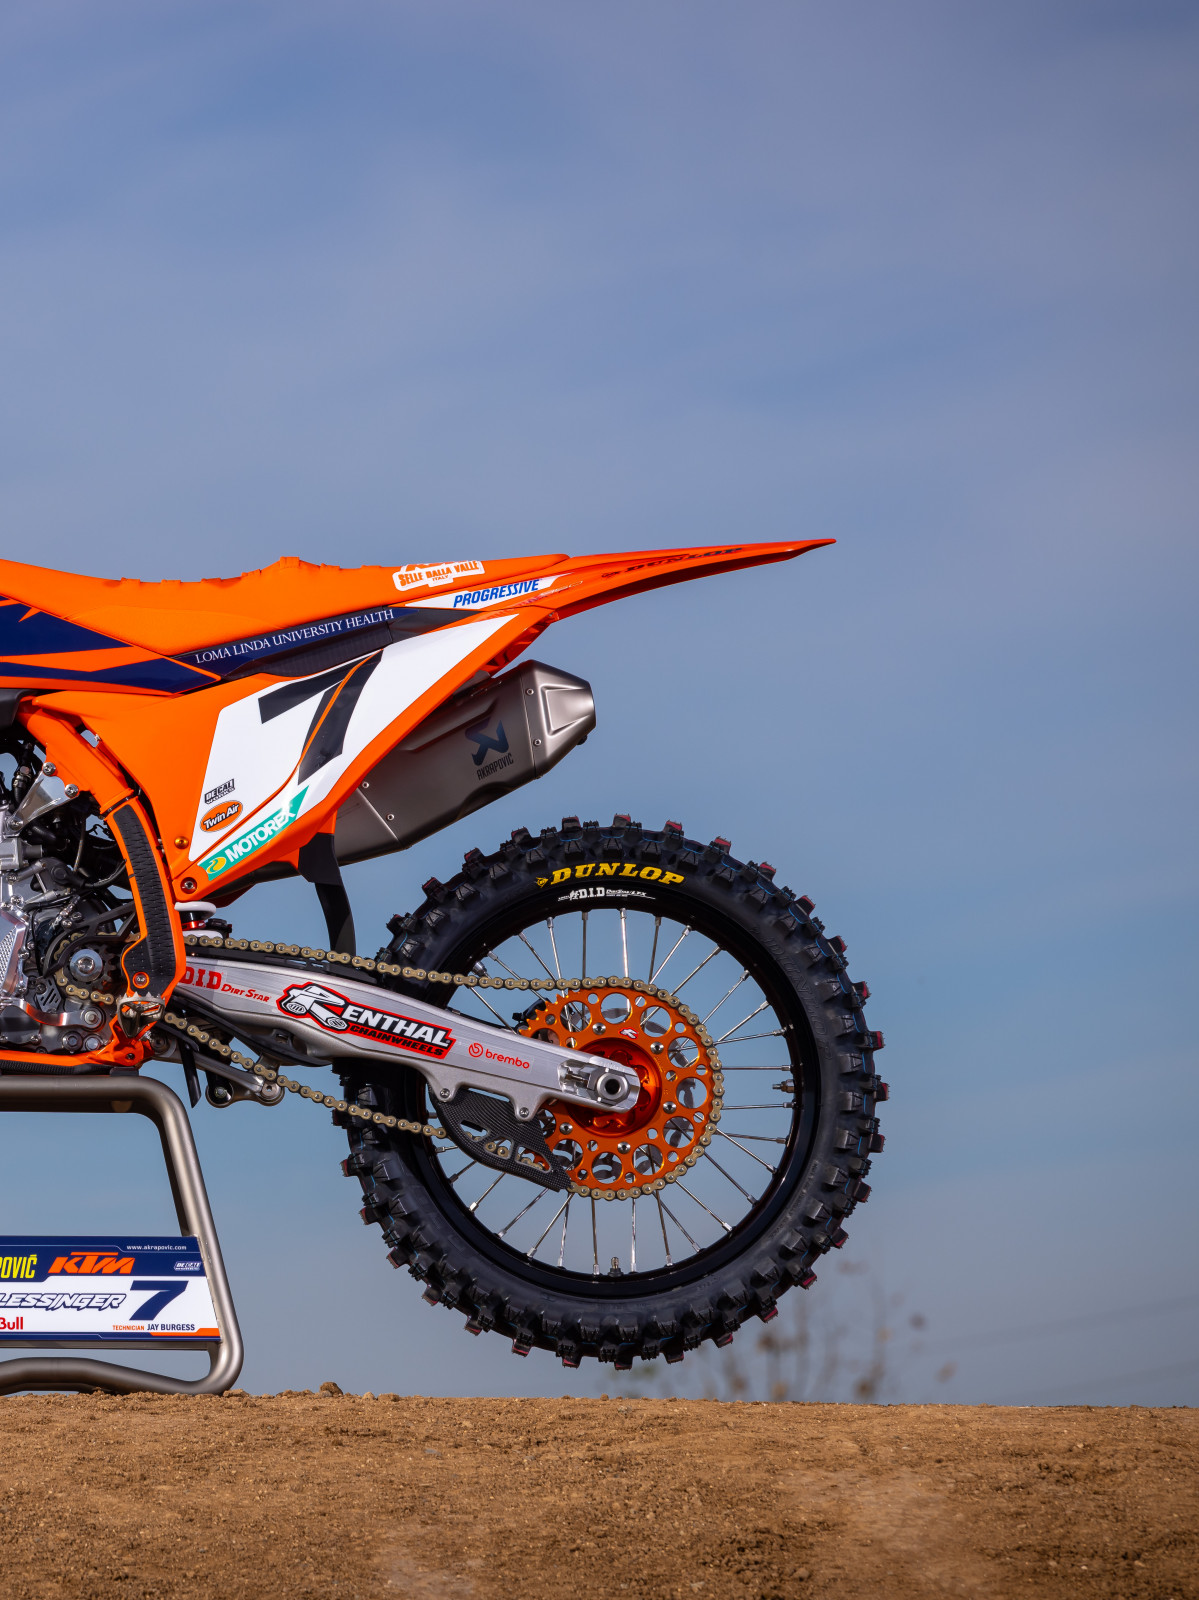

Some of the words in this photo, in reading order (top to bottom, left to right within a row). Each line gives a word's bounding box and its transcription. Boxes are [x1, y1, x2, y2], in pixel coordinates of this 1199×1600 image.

[398, 571, 423, 587] SELLE
[454, 560, 480, 573] VALLE
[453, 578, 540, 608] PROGRESSIVE
[194, 647, 232, 664] LOMA
[233, 638, 271, 656] LINDA
[272, 620, 342, 646] UNIVERSITY
[346, 609, 394, 629] HEALTH
[258, 648, 384, 785] 7
[203, 811, 226, 830] Twin
[226, 803, 240, 818] Air
[224, 803, 296, 863] MOTOREX
[550, 862, 685, 885] DUNLOP
[281, 983, 452, 1048] RENTHAL
[350, 1024, 445, 1057] CHAINWHEELS
[485, 1048, 530, 1069] brembo
[48, 1252, 136, 1274] KTM
[129, 1280, 189, 1321] 7
[147, 1323, 160, 1331] JAY
[161, 1323, 196, 1331] BURGESS
